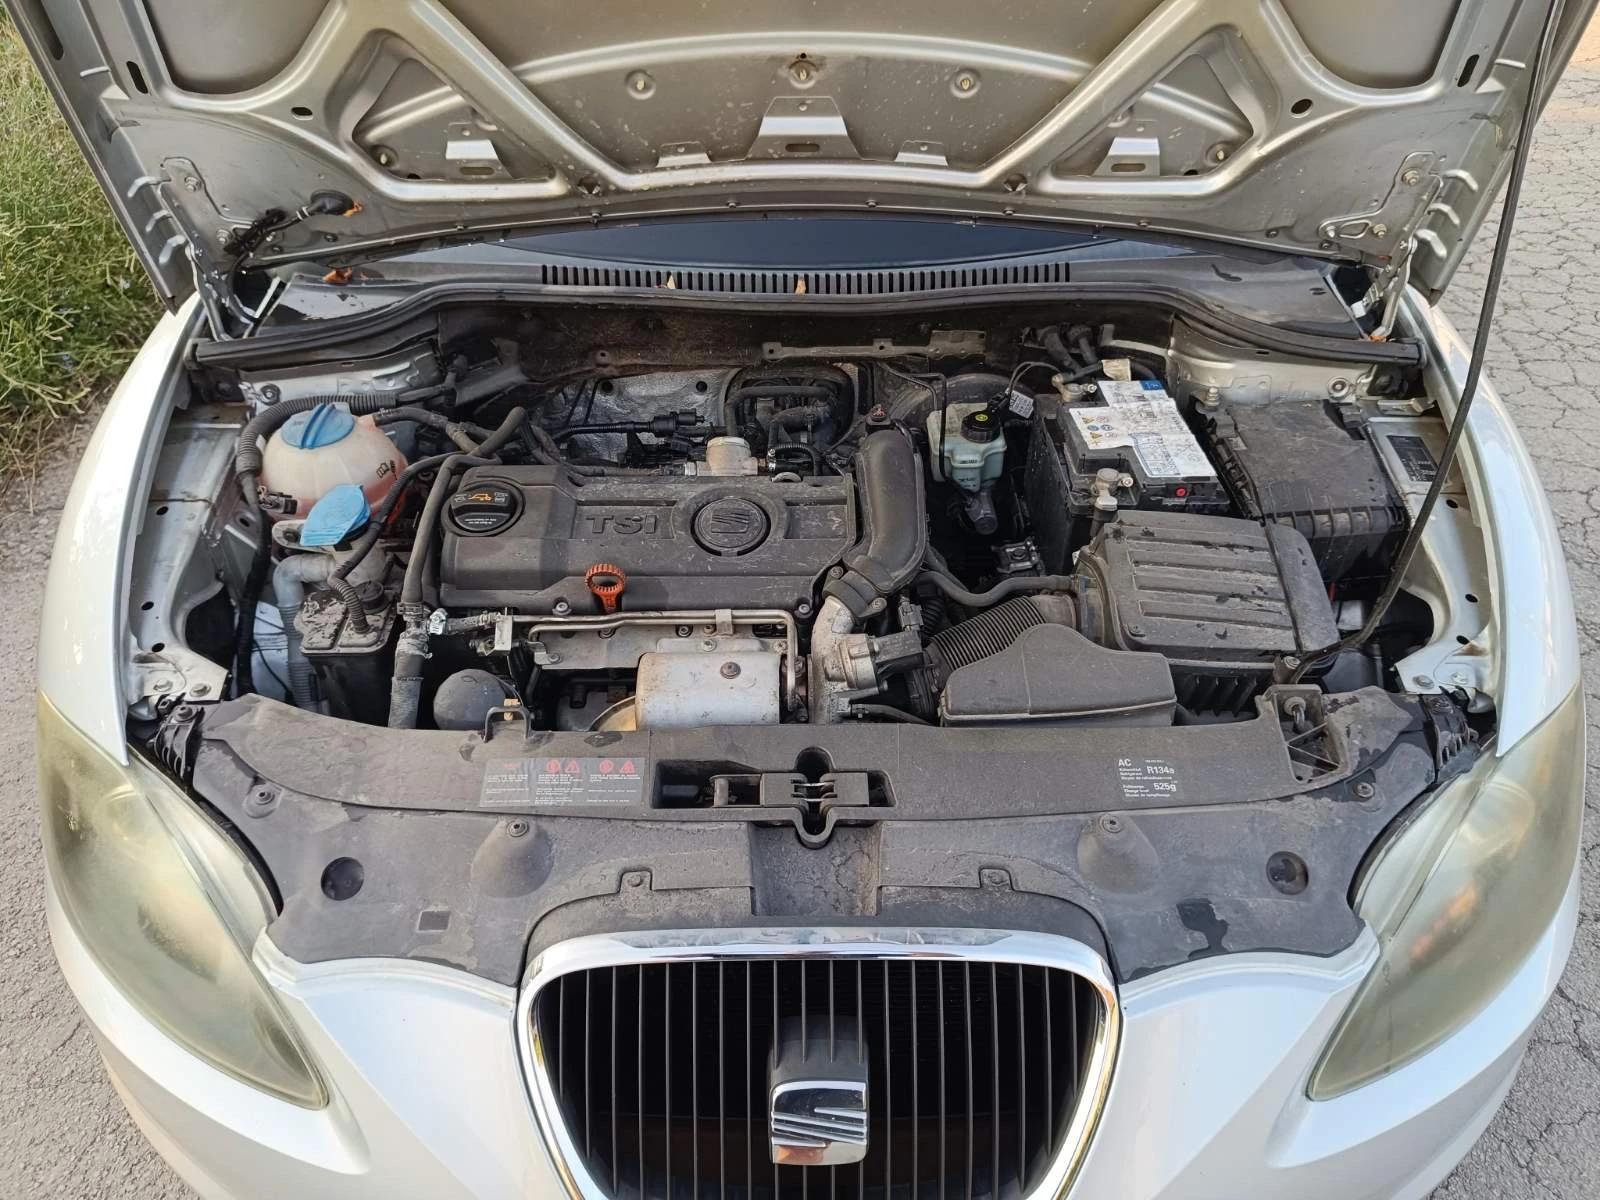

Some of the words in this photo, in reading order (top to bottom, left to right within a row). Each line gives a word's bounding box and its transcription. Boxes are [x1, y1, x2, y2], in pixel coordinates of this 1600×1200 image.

[585, 514, 658, 535] TSI
[1118, 758, 1131, 766] AC
[1146, 765, 1175, 774] R134a
[1153, 782, 1176, 792] 525g
